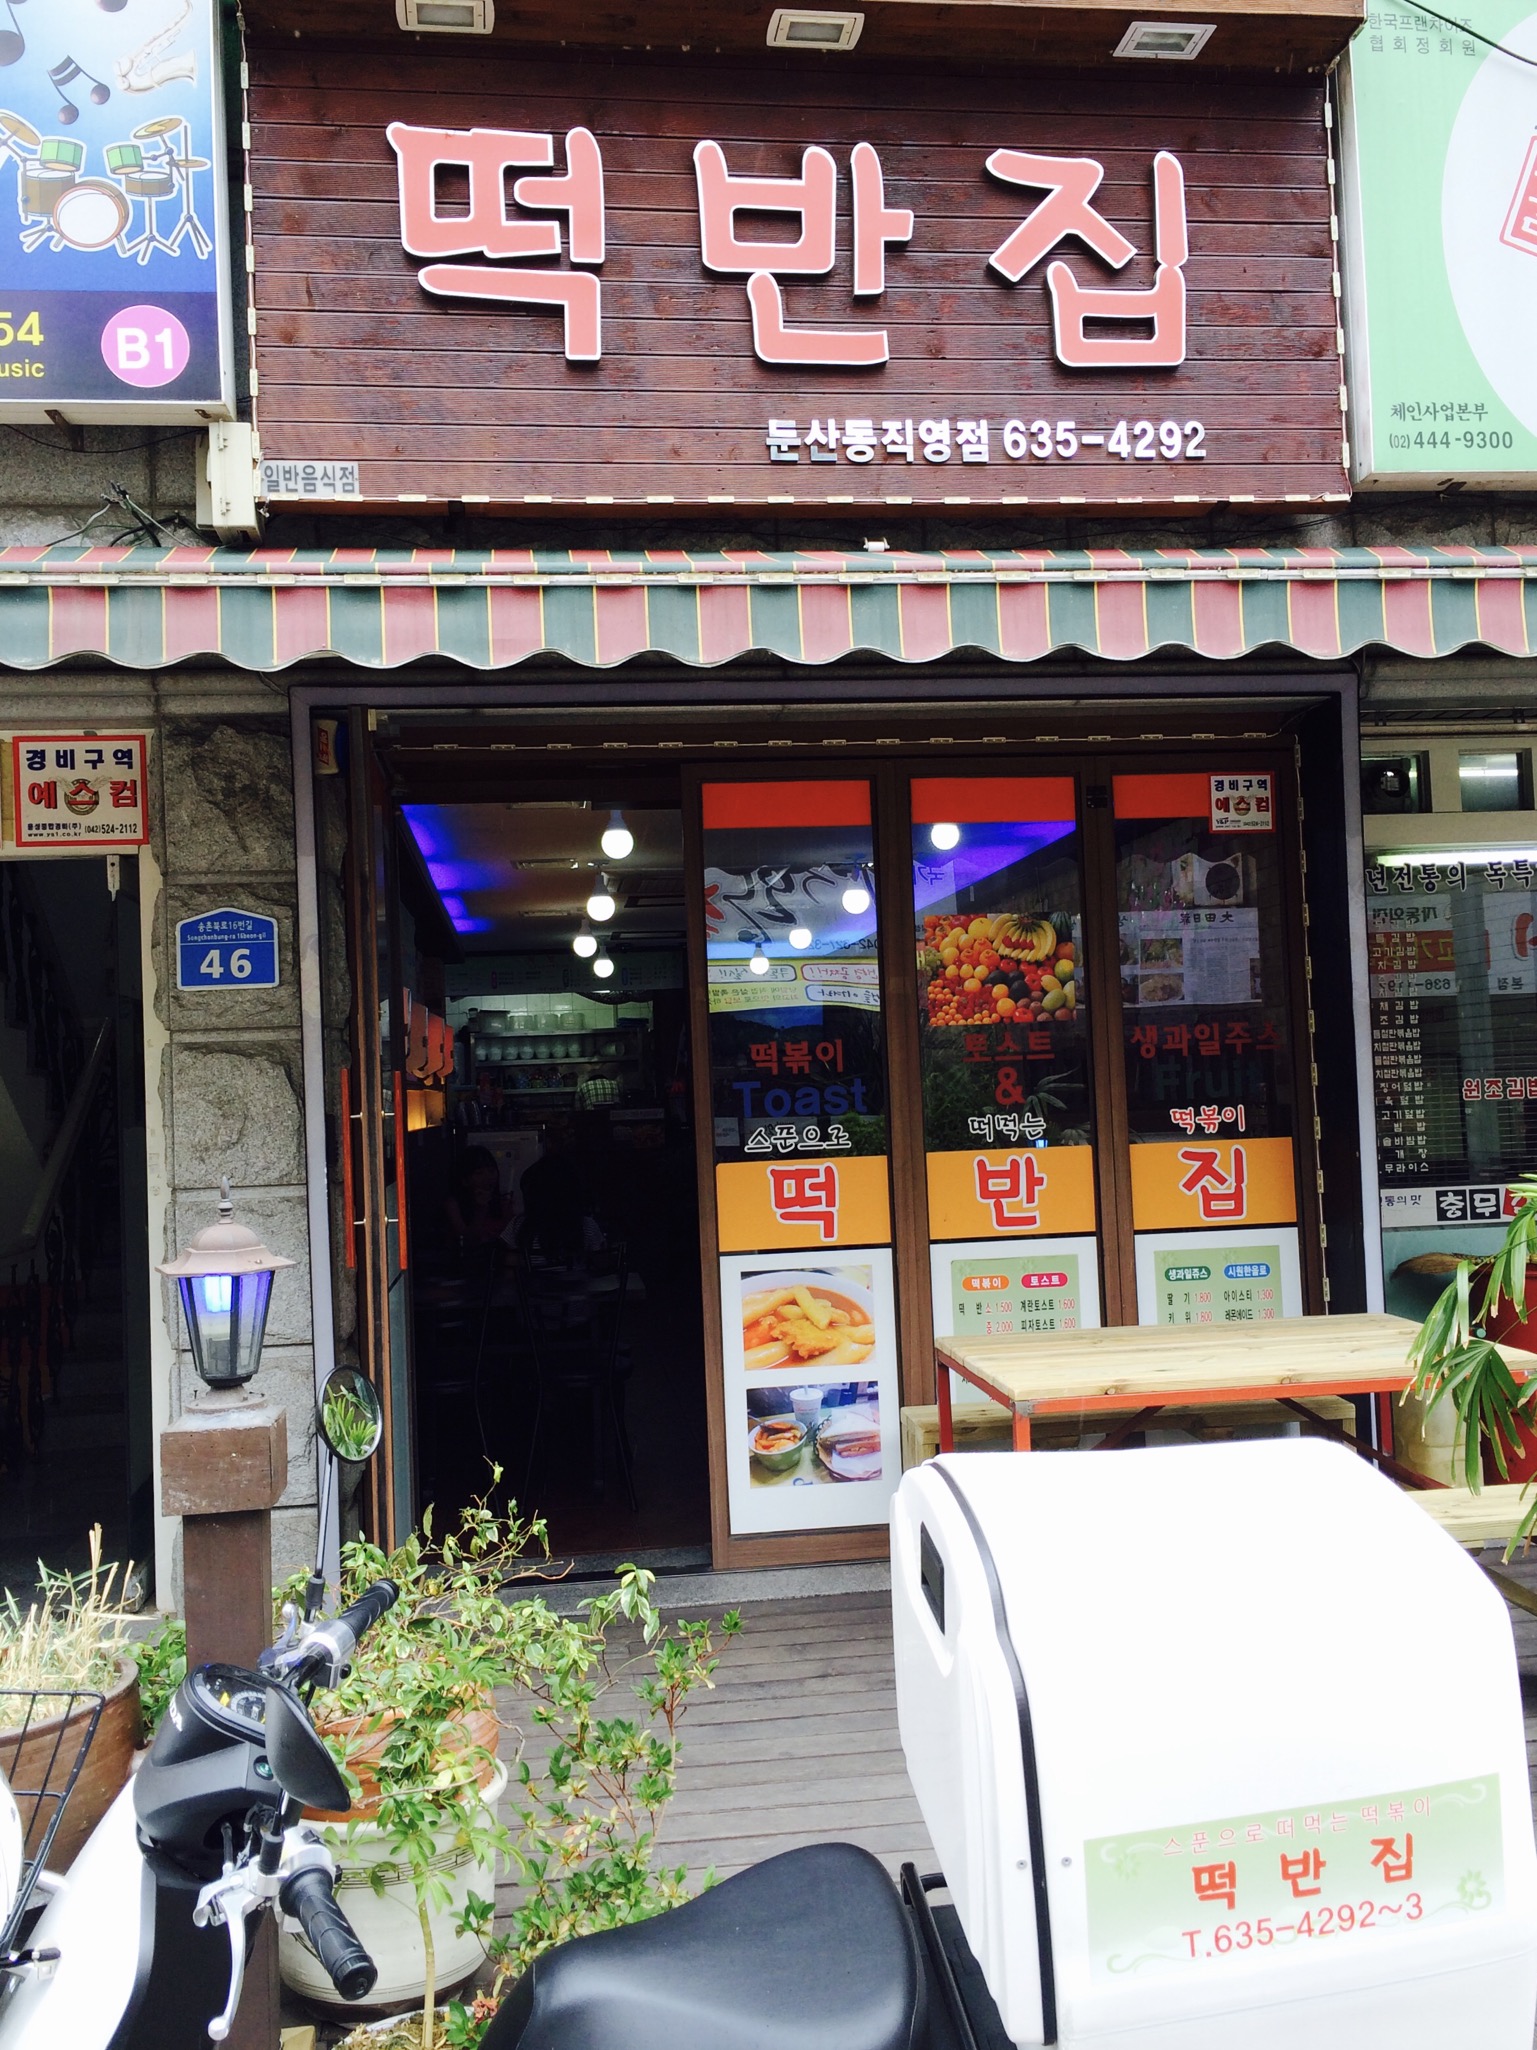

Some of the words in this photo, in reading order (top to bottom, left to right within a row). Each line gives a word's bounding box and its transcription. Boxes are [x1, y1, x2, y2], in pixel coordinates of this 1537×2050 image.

[116, 327, 175, 370] B1
[1390, 402, 1489, 422] 체인사업본부
[765, 418, 990, 463] 둔산동직영점
[1003, 419, 1207, 460] 635-4292
[262, 463, 357, 494] 일반음식점
[25, 748, 133, 771] 경비구역
[1214, 778, 1268, 792] 경비구역
[200, 948, 252, 979] 46
[963, 1031, 1055, 1064] 토스트
[1129, 1020, 1282, 1060] 생과일주스
[749, 1038, 844, 1076] 떡볶이
[732, 1078, 867, 1118] Toast
[1376, 1095, 1425, 1106] 육덮밥
[968, 1112, 1047, 1142] 떠먹는
[1170, 1104, 1246, 1135] 떡볶이
[744, 1124, 852, 1154] 스푼으로
[973, 1153, 1048, 1231] 반
[1177, 1144, 1249, 1221] 집
[767, 1161, 839, 1242] 떡
[1410, 1194, 1422, 1206] 맛
[971, 1277, 1002, 1289] 떡볶이
[1030, 1274, 1061, 1286] 토스트
[1224, 1289, 1252, 1302] 아이스티
[1020, 1299, 1055, 1313] 계란토스트
[1021, 1318, 1056, 1332] 피자토스트
[1162, 1823, 1265, 1857] 스푼으로
[1276, 1811, 1348, 1840] 떠먹는
[1361, 1795, 1431, 1825] 떡볶이
